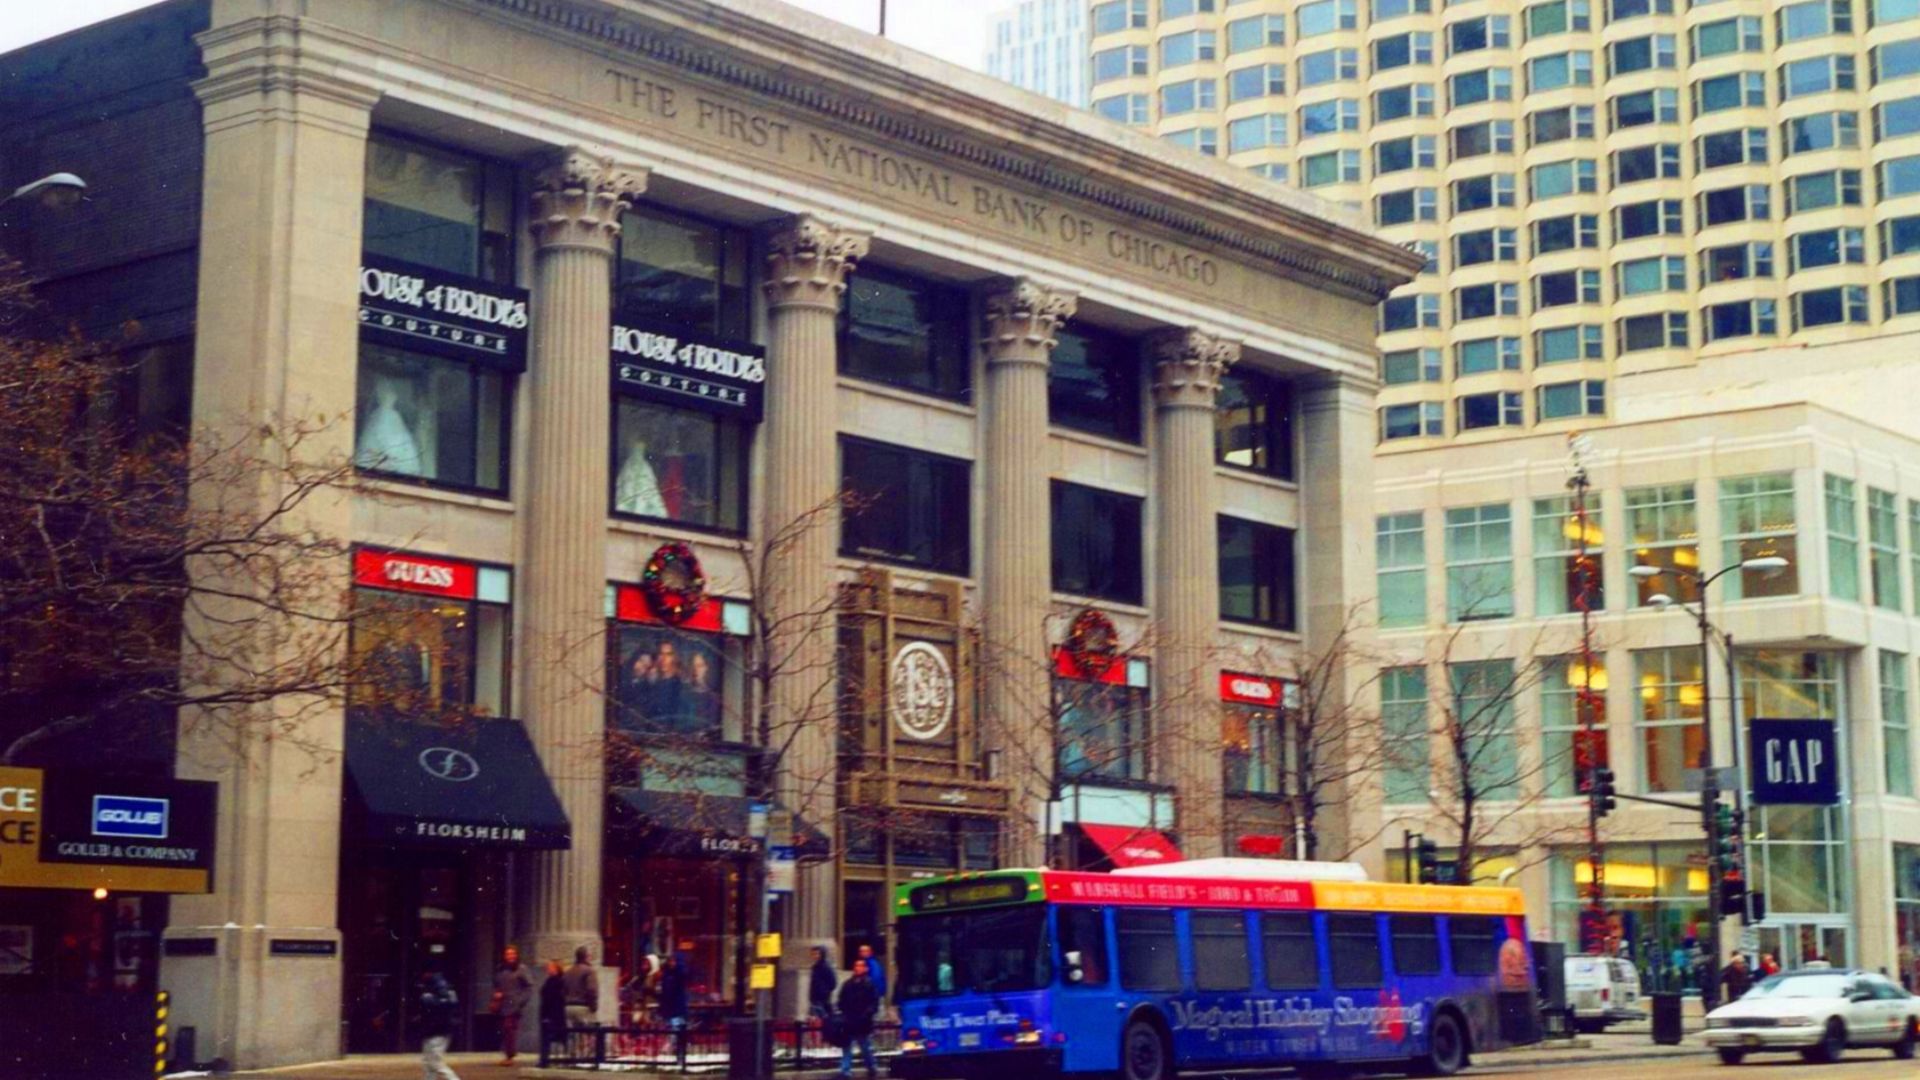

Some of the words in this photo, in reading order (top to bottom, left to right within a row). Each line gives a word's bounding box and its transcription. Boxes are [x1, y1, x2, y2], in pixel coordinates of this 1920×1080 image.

[606, 69, 677, 118] THE
[695, 97, 790, 154] FIRST
[808, 132, 958, 206] NATIONAL
[972, 185, 1048, 234] BANK
[1060, 213, 1094, 246] OF
[1107, 230, 1218, 286] CHICAGO
[444, 286, 528, 329] BRIDES
[611, 324, 677, 364] HOUSE
[694, 344, 766, 383] BRIDES
[384, 559, 454, 588] GUESS
[1766, 738, 1823, 784] GAP
[98, 808, 163, 825] GOLUB
[416, 822, 527, 842] FLORSHEIM
[58, 841, 111, 857] GOLUB
[126, 845, 197, 861] COMPANY
[1070, 881, 1145, 899] MARSHALL
[1170, 998, 1255, 1041] Magical
[1256, 996, 1334, 1036] Holiday
[1333, 996, 1426, 1036] Shopping
